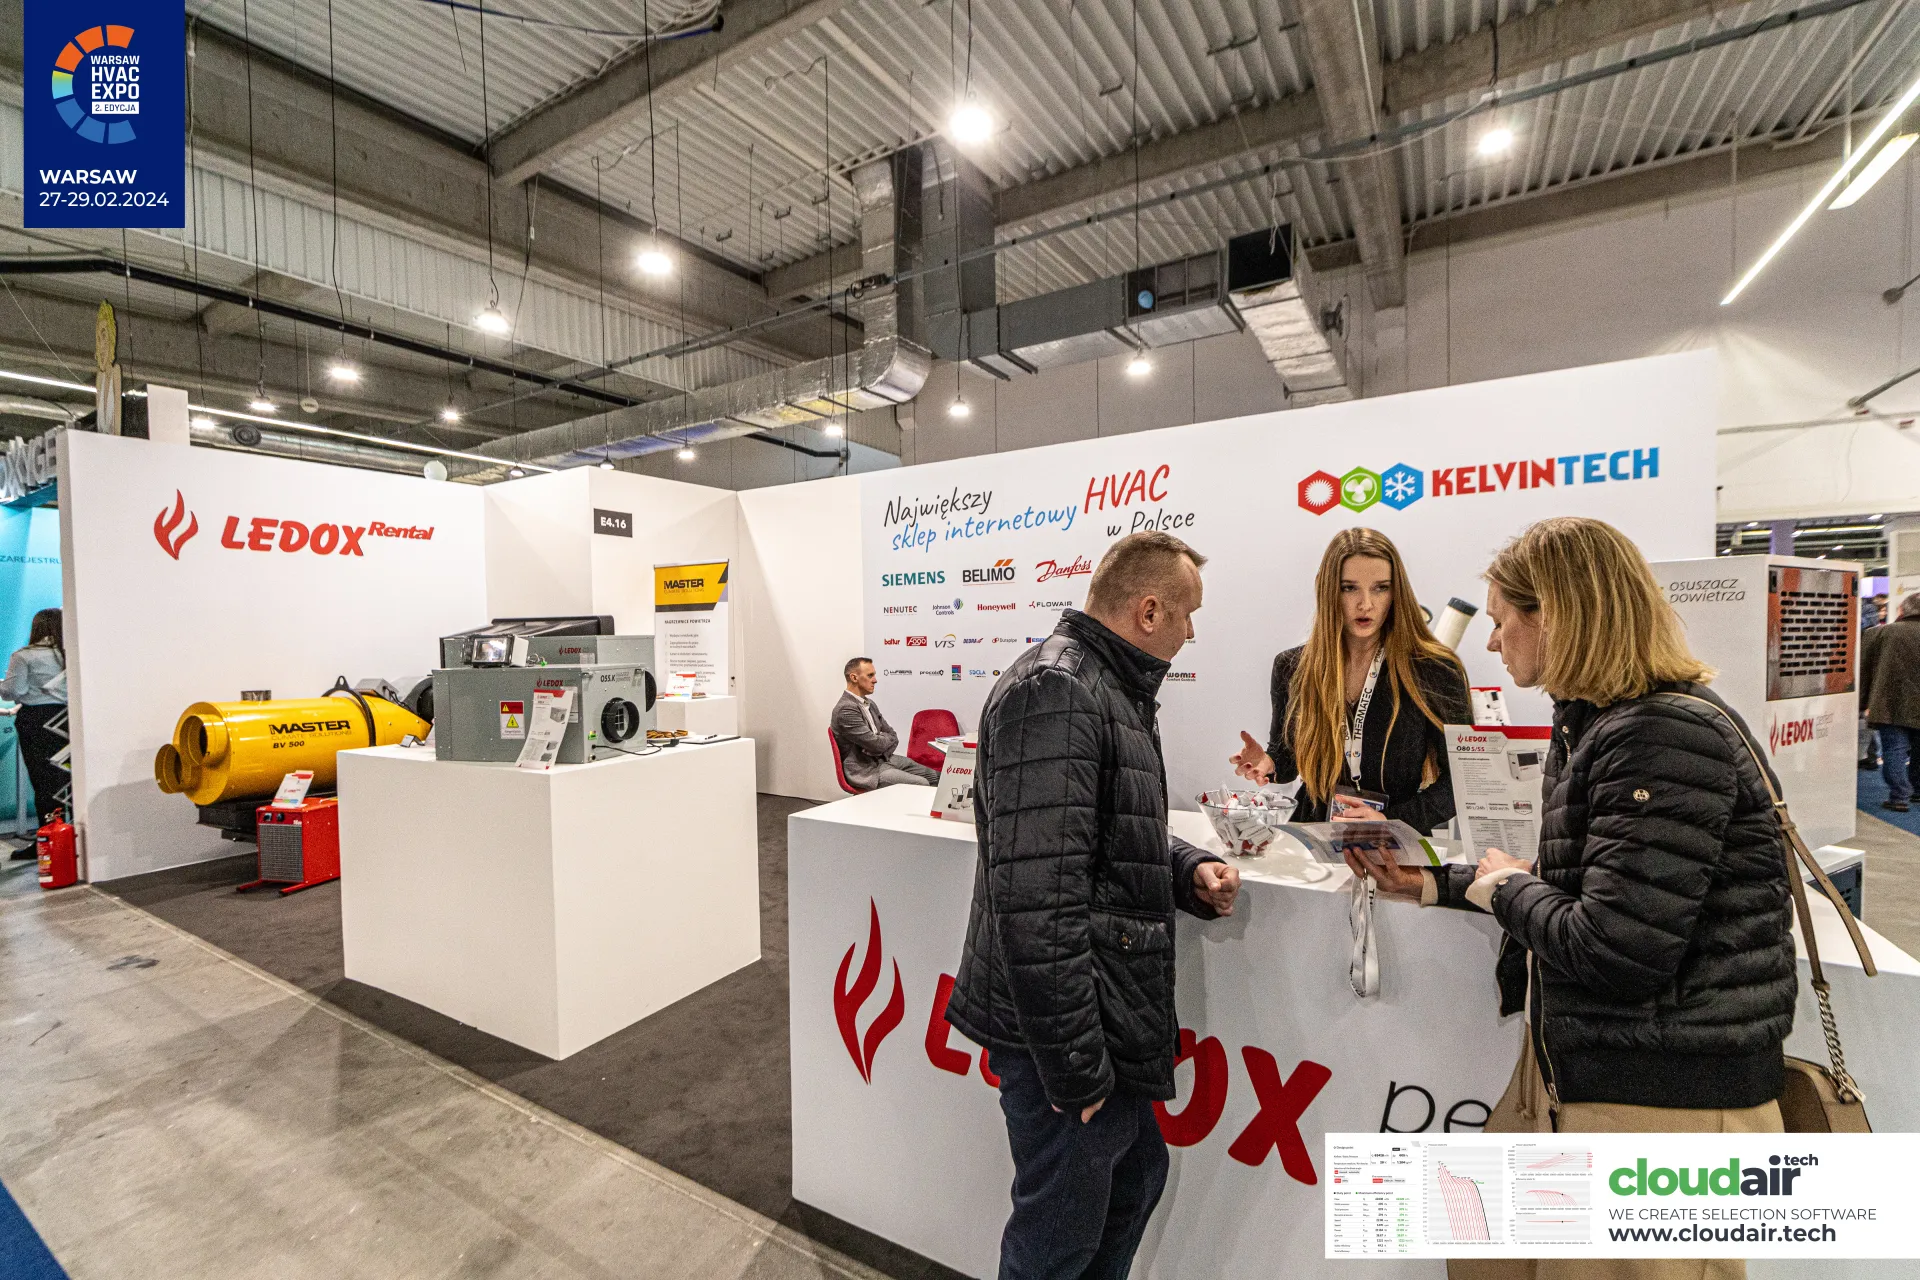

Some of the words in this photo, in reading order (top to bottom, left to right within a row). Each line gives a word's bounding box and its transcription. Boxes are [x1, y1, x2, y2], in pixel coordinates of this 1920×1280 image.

[1431, 446, 1660, 498] KELVINTECH
[884, 486, 993, 527] Największy
[891, 522, 937, 552] sklep
[945, 505, 1077, 541] internetowy
[1084, 463, 1171, 515] HVAC
[600, 516, 627, 530] E4.16
[1107, 525, 1123, 538] w
[1130, 508, 1195, 535] Polsce
[220, 515, 367, 557] LEDOX
[367, 520, 435, 541] Rental
[962, 565, 1015, 583] BELIMO
[1035, 554, 1092, 583] Danfoss
[663, 578, 704, 590] MASTER
[882, 570, 946, 587] SIEMENS
[1669, 578, 1739, 591] osuszacz
[1669, 589, 1746, 604] powietrza
[883, 605, 918, 614] NENUTEC
[932, 604, 951, 612] Johnson
[977, 602, 1016, 613] Honeywell
[884, 638, 901, 646] baltur
[935, 640, 956, 648] VTS
[543, 679, 563, 687] LEDOX
[1353, 687, 1373, 740] THERMATEC
[268, 720, 351, 735] MASTER
[1780, 717, 1815, 747] LEDOX
[288, 740, 305, 748] 500
[1464, 735, 1487, 743] LEDOX
[952, 767, 973, 775] LEDOX
